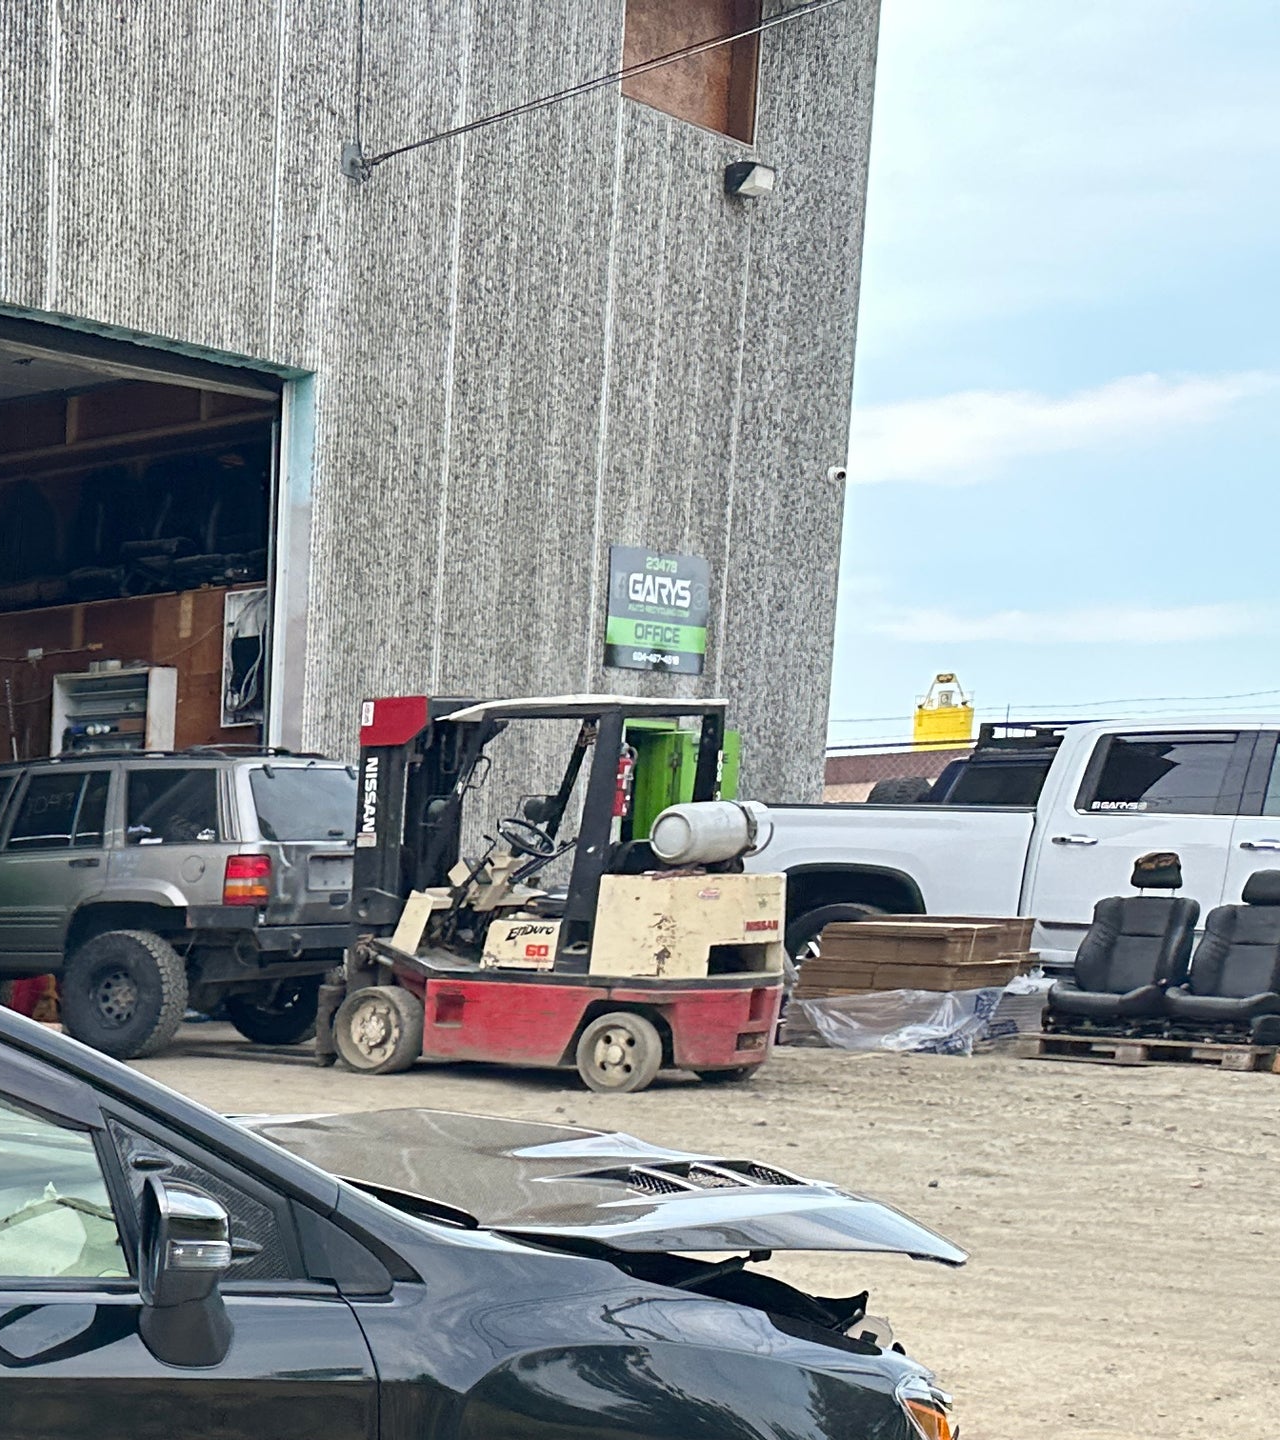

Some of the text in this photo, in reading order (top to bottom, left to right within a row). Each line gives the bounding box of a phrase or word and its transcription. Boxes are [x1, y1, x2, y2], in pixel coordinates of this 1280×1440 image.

[628, 573, 692, 608] GARYS
[634, 623, 681, 644] OFFICE
[362, 757, 379, 832] NISSAN
[525, 944, 549, 957] 60
